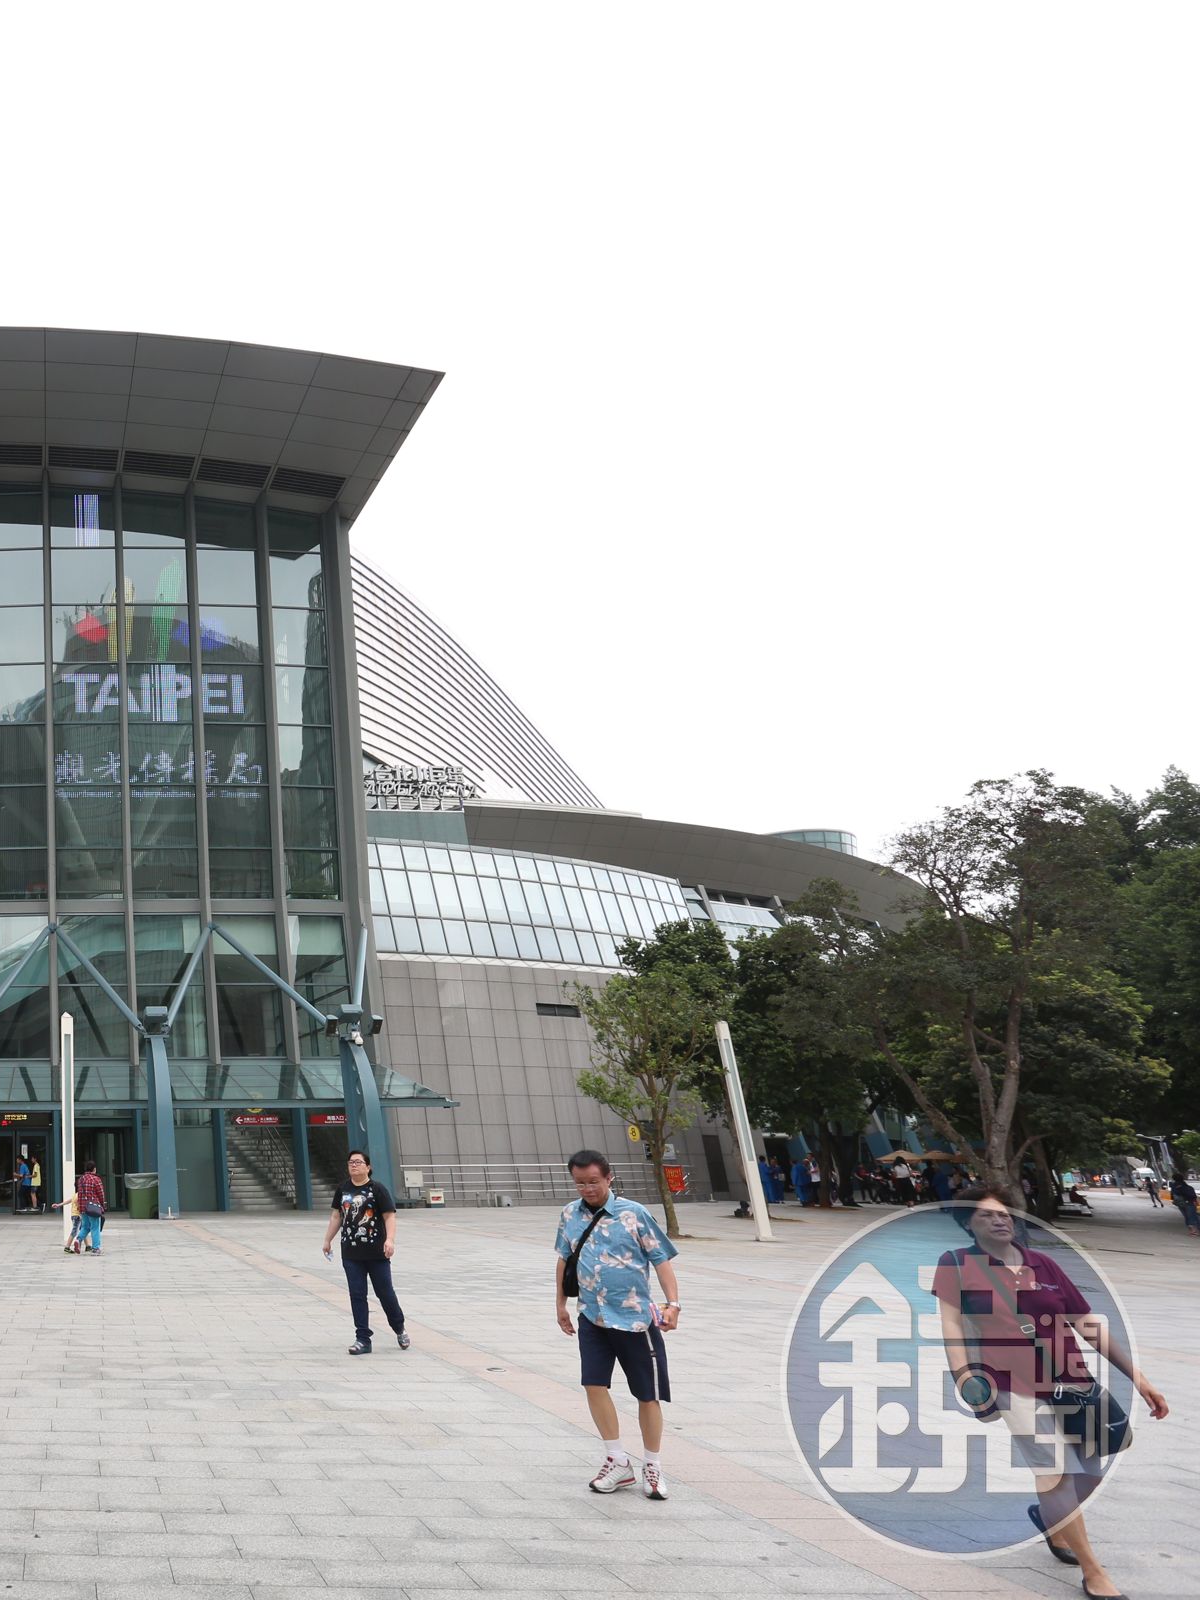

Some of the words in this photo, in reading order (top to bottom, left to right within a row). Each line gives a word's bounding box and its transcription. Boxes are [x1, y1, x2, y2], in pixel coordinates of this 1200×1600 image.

[61, 671, 246, 717] TAIPEI
[374, 763, 464, 784] 台北小巨蛋
